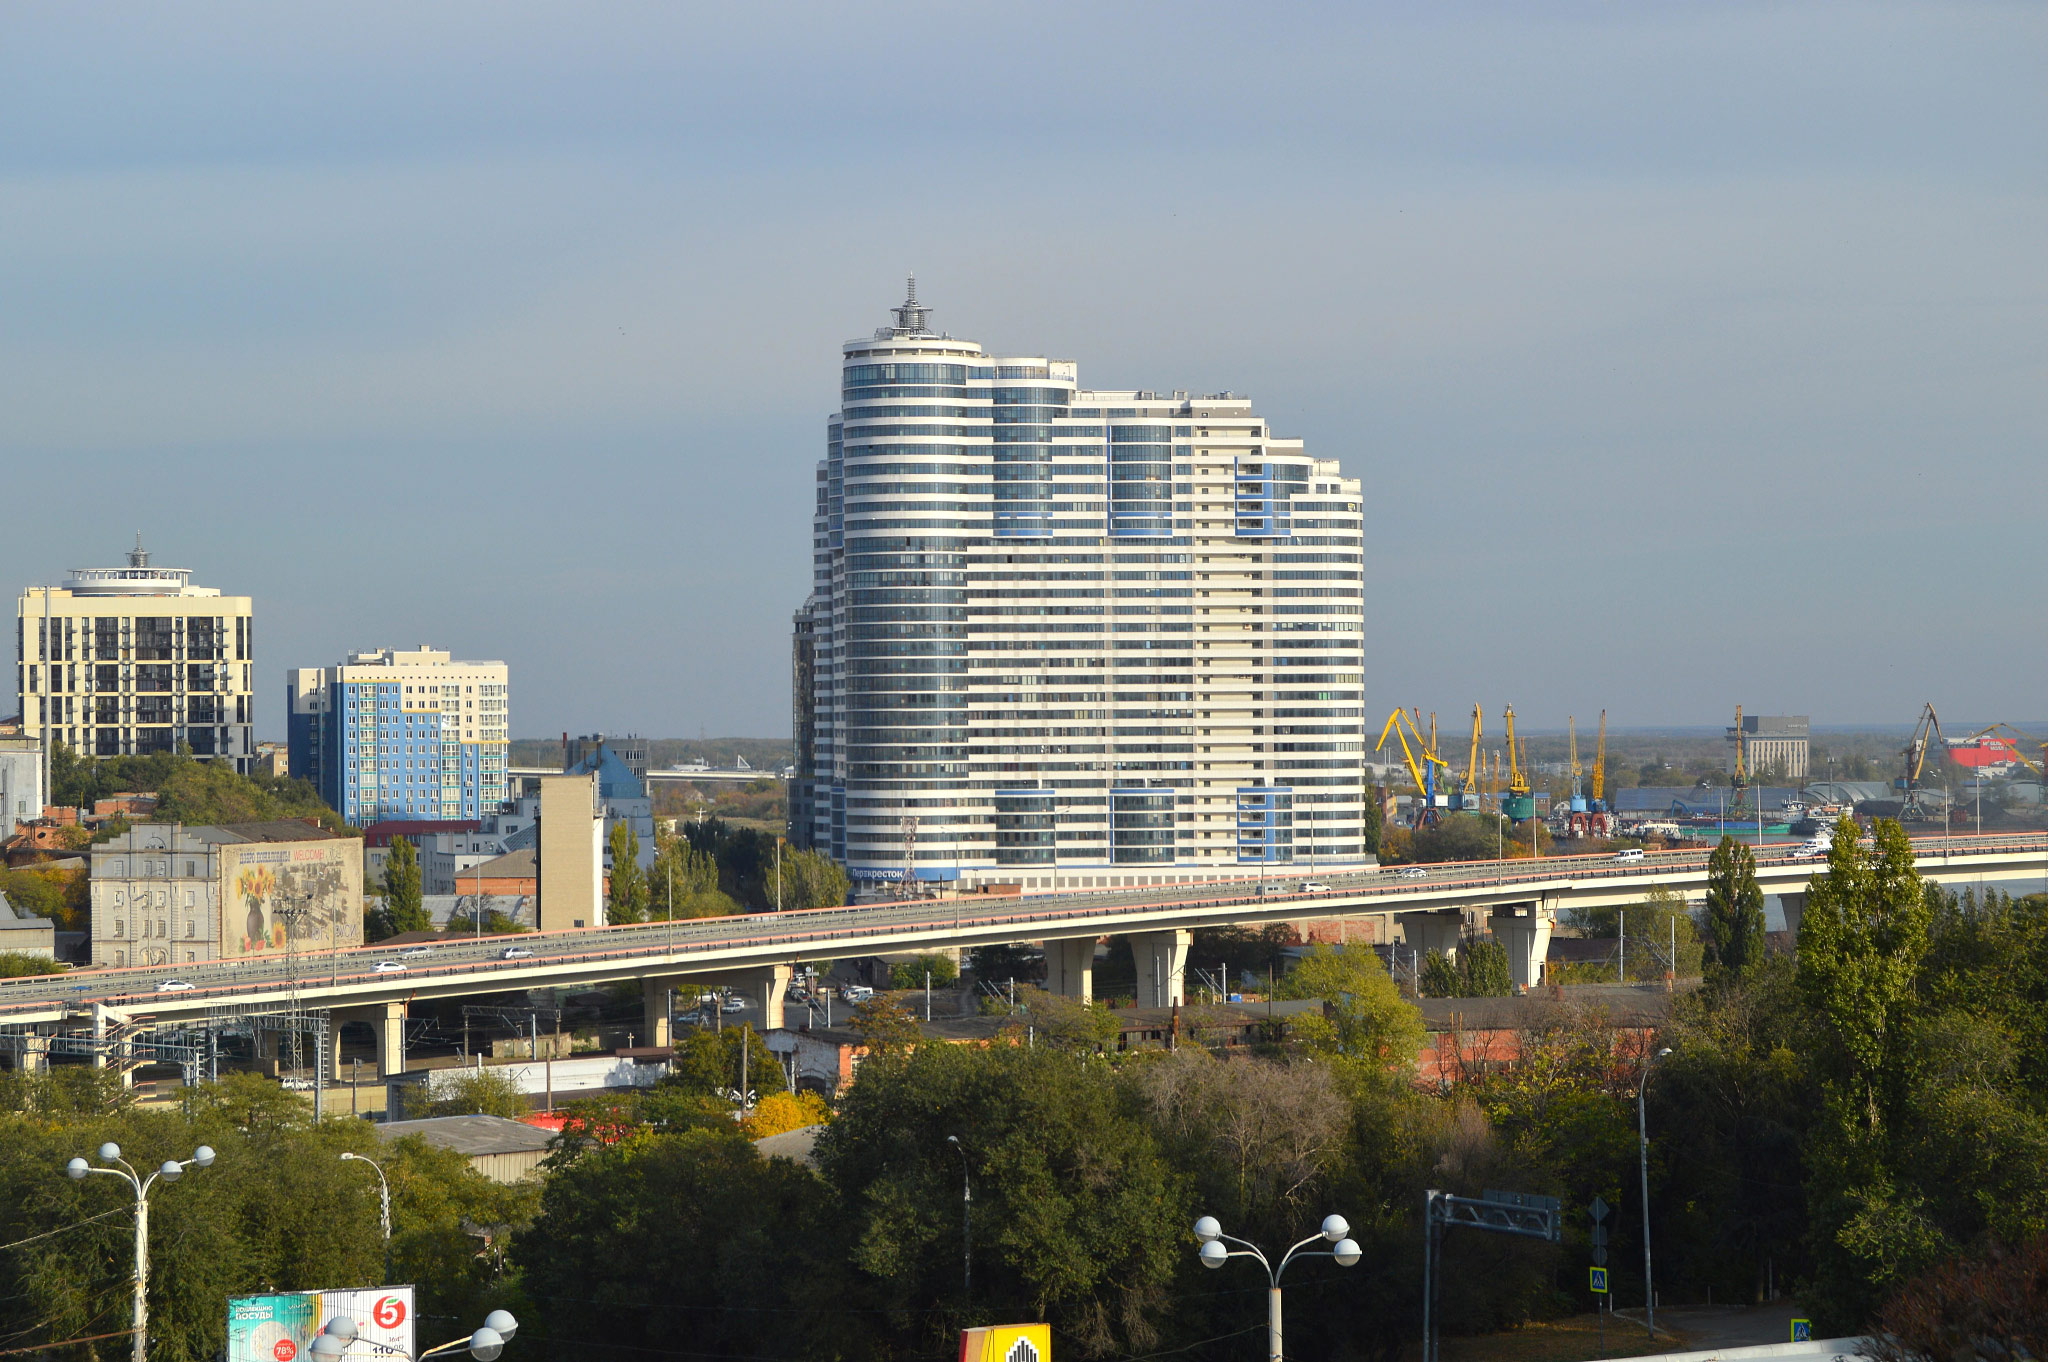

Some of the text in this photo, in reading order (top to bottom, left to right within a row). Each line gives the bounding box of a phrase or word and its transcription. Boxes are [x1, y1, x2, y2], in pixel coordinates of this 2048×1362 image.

[853, 869, 902, 879] Перекресток
[379, 1295, 402, 1326] 5
[235, 1311, 273, 1320] ПОСУДЫ
[276, 1346, 294, 1355] 78%
